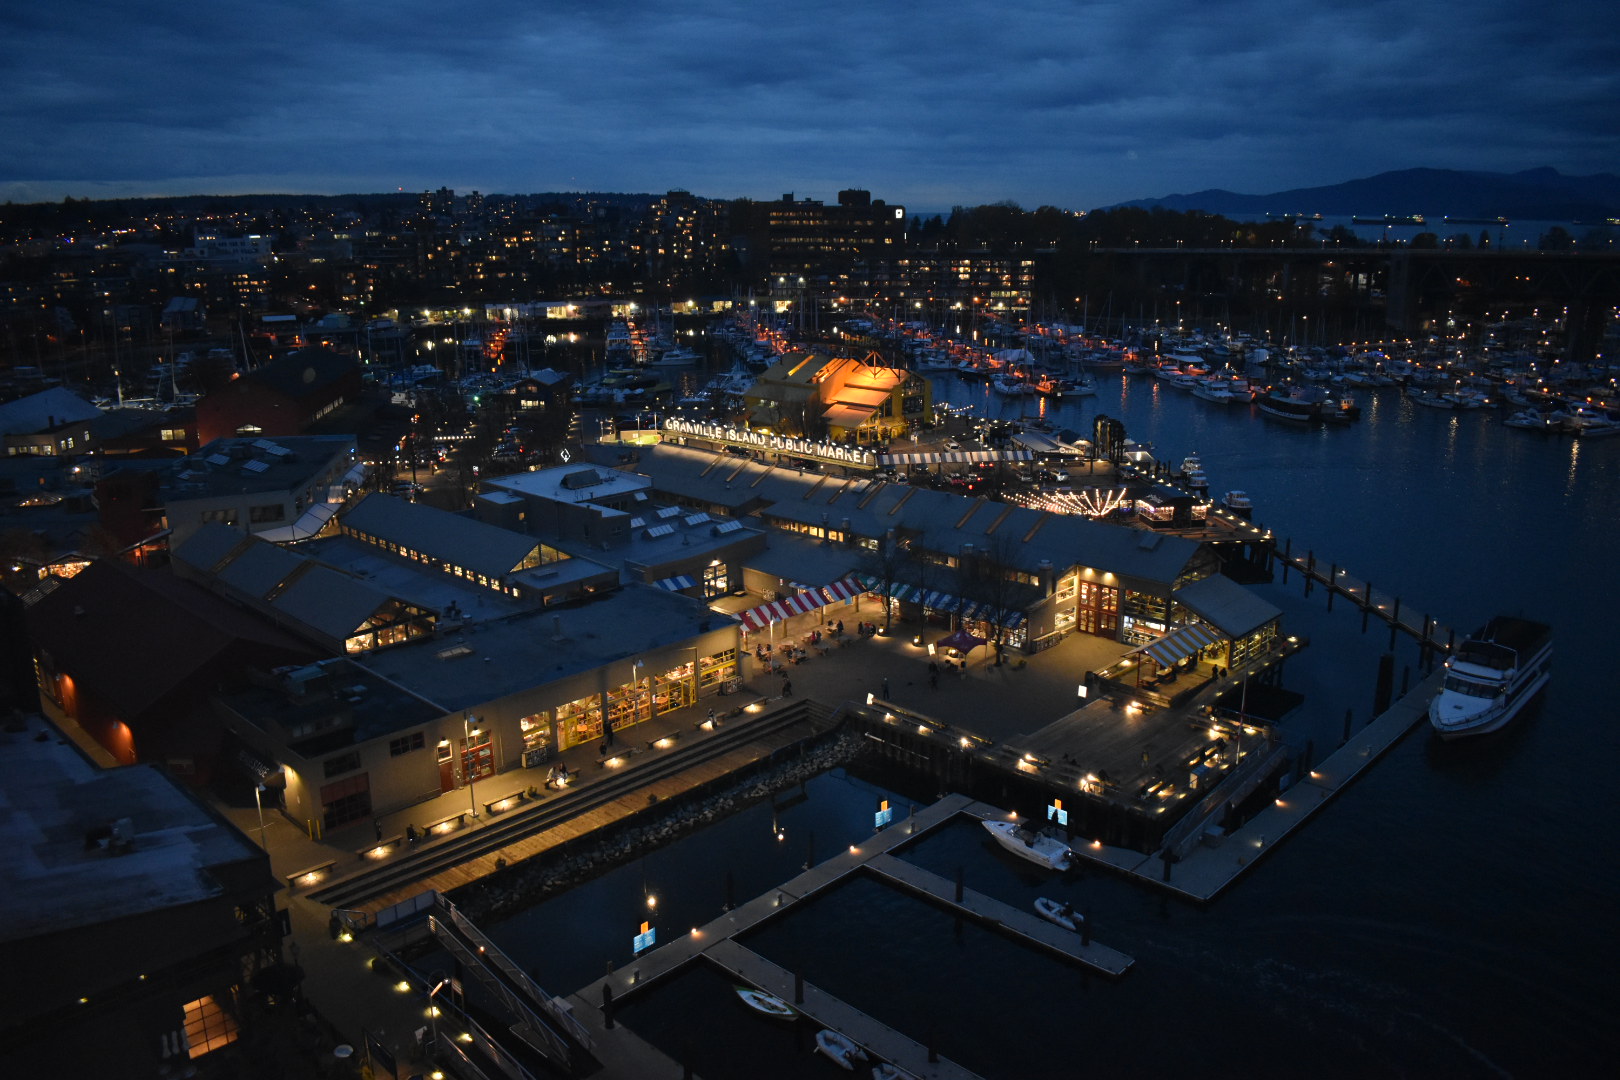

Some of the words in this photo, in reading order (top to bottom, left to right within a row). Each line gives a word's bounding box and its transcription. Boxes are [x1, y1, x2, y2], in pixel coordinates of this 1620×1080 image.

[665, 418, 722, 439] GRANVILLE
[726, 430, 766, 446] ISLAND
[769, 437, 813, 454] PUBLIC
[817, 444, 869, 464] MARKET
